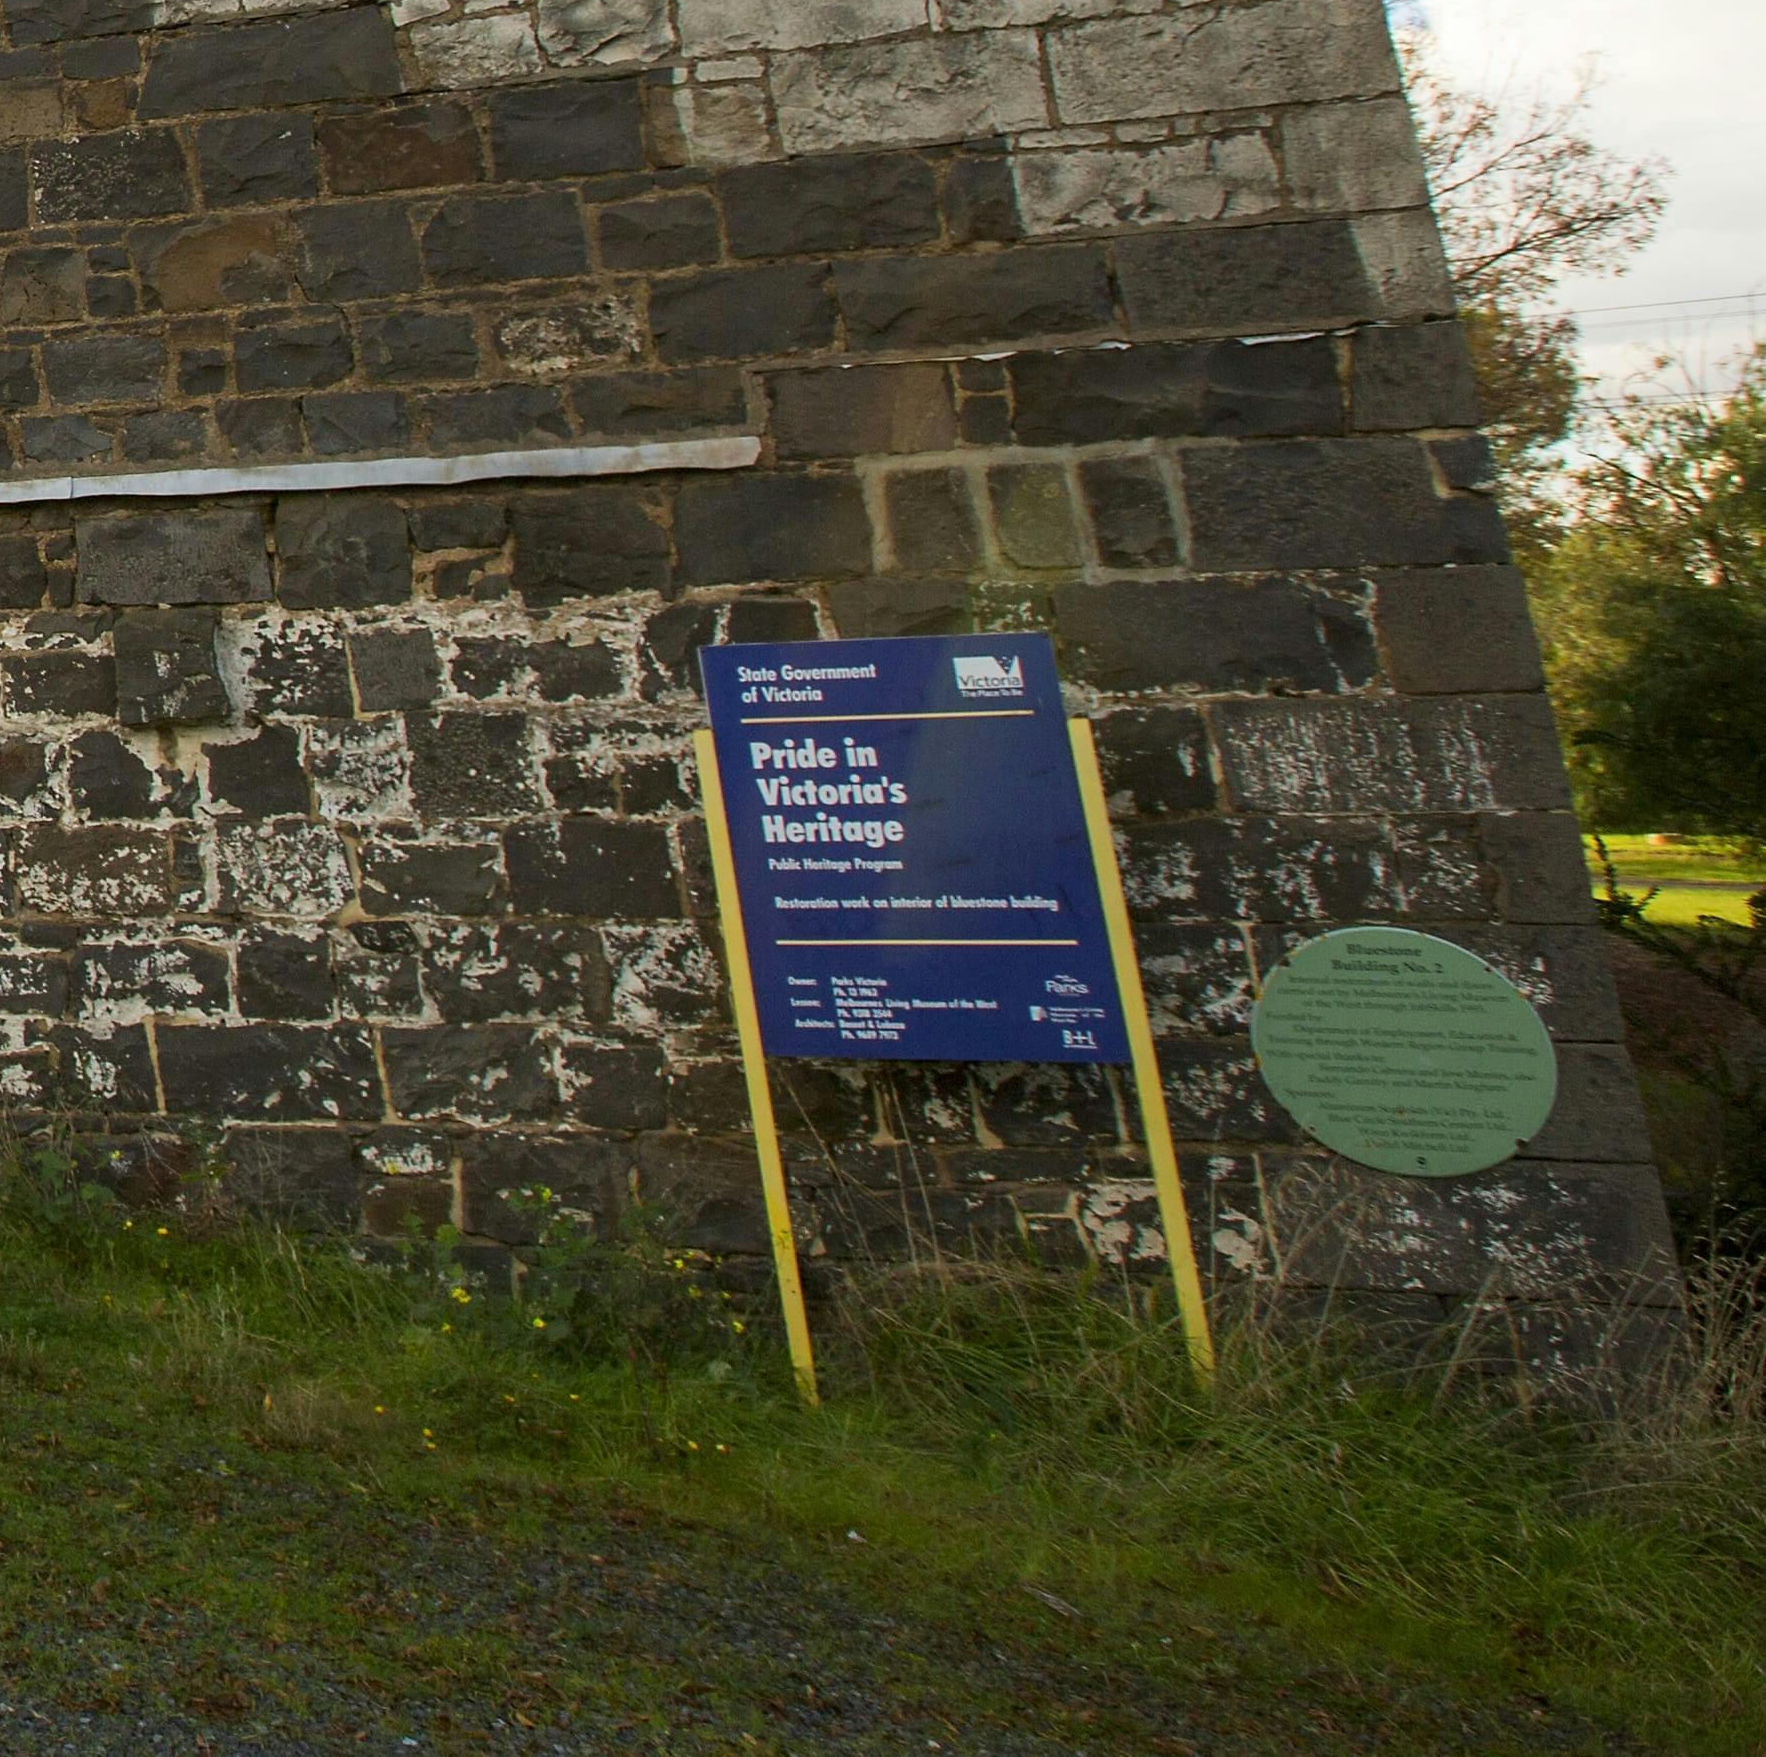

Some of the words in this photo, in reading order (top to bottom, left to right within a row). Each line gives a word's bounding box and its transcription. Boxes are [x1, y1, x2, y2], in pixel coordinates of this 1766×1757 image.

[737, 666, 777, 682] State
[781, 664, 877, 681] Government
[959, 675, 1021, 688] Victoria
[741, 686, 758, 703] of
[761, 686, 823, 703] Victoria
[749, 738, 837, 770] Pride
[843, 736, 878, 768] in
[756, 774, 908, 806] Victoria's
[761, 811, 904, 849] Heritage
[768, 857, 802, 871] Public
[803, 857, 852, 873] Heritage
[853, 856, 903, 873] Program
[774, 896, 838, 909] Restoration
[841, 896, 870, 908] work
[873, 898, 888, 908] on
[889, 896, 931, 908] interior
[935, 895, 948, 908] of
[950, 895, 1008, 908] bluestone
[1009, 895, 1058, 911] building
[1345, 944, 1423, 957] Bluestone
[1330, 959, 1400, 975] Building
[1403, 962, 1431, 973] No.
[1434, 963, 1444, 974] 2
[1045, 980, 1089, 994] Parks
